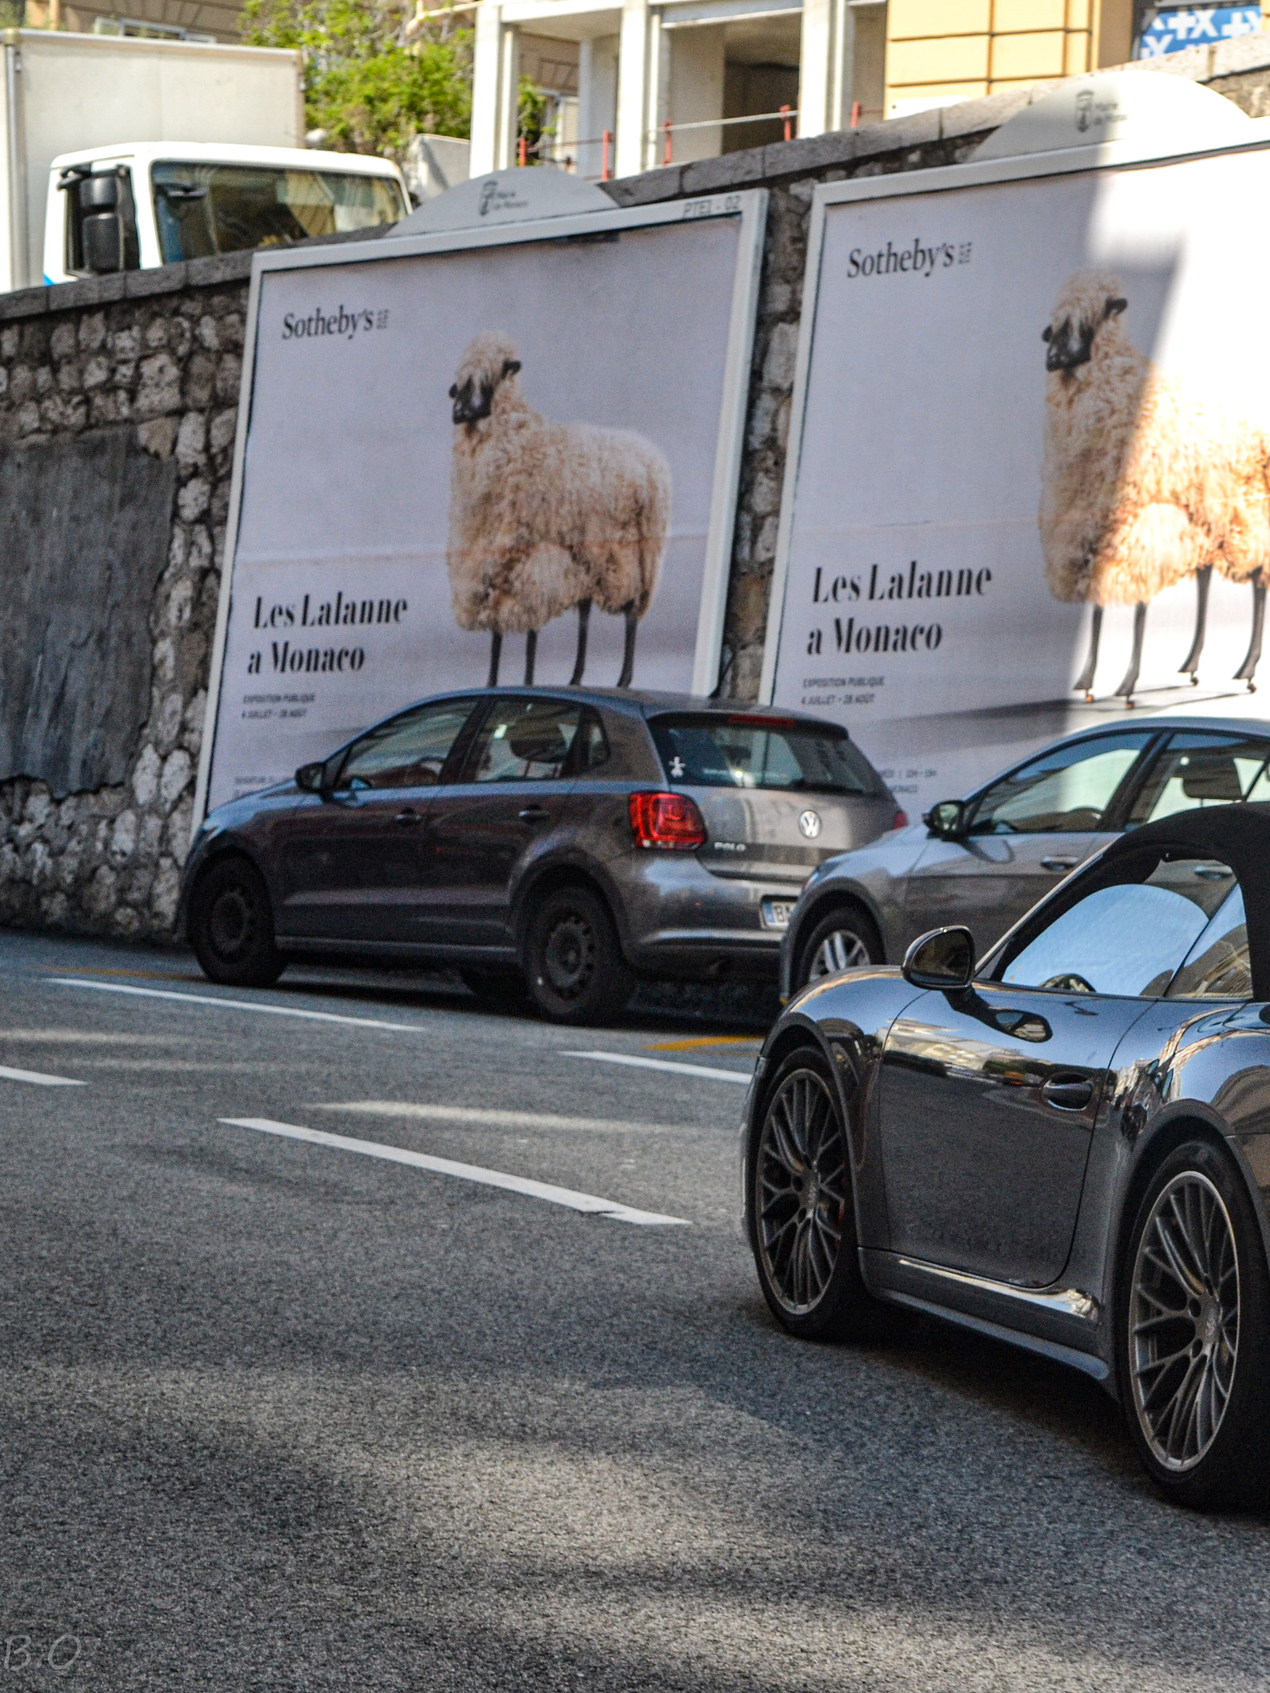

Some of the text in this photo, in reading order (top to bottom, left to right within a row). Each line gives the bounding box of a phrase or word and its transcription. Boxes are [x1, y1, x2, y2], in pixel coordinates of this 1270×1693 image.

[847, 237, 955, 278] Sotheby's
[282, 304, 374, 340] Sotheby's
[813, 560, 992, 602] Les Lalanne
[254, 591, 407, 629] Les Lalanne
[834, 617, 943, 653] Monaco
[272, 641, 365, 673] Monaco
